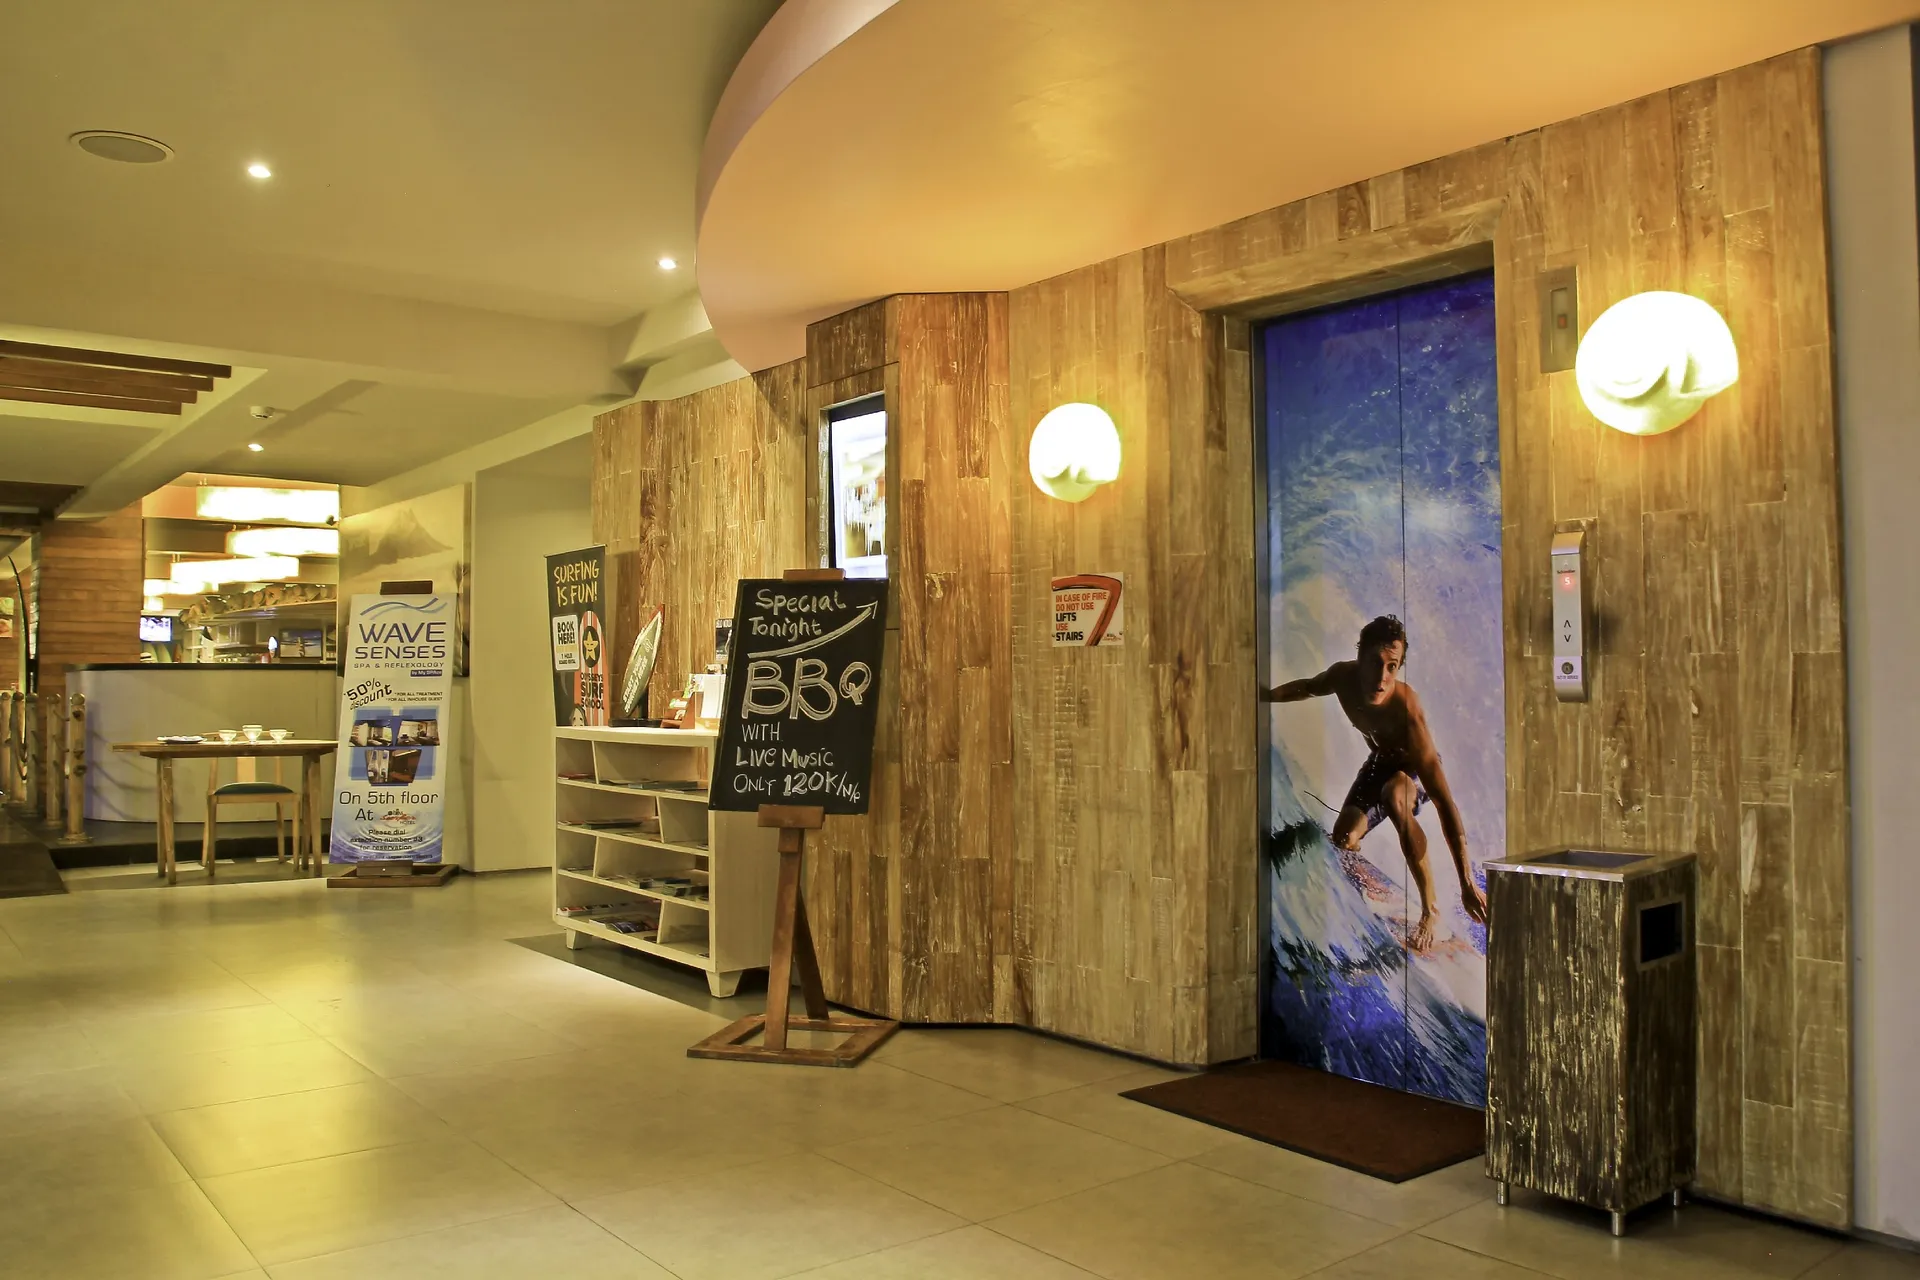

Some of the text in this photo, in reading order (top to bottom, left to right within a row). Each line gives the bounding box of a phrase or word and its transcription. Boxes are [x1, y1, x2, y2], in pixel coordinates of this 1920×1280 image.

[553, 559, 600, 584] SURFING
[556, 581, 598, 607] IS FUN!
[1063, 594, 1081, 603] CASE
[1081, 593, 1091, 602] OF
[1092, 592, 1107, 601] FIRE
[755, 588, 847, 616] Special
[1066, 602, 1080, 612] NOT
[1081, 602, 1094, 610] USE
[1056, 613, 1076, 622] LIFTS
[359, 622, 446, 643] WAVE
[557, 620, 575, 634] BOOK
[748, 616, 822, 642] Tonight
[557, 632, 576, 645] HERE!
[1056, 631, 1083, 641] STAIRS
[354, 645, 446, 660] SENSES
[580, 681, 604, 699] SURF
[741, 657, 872, 721] BBQ
[580, 699, 605, 711] SCHOOL
[741, 722, 781, 742] WITH
[339, 790, 439, 805] On 5th floor
[354, 808, 374, 821] At
[393, 828, 406, 836] dial
